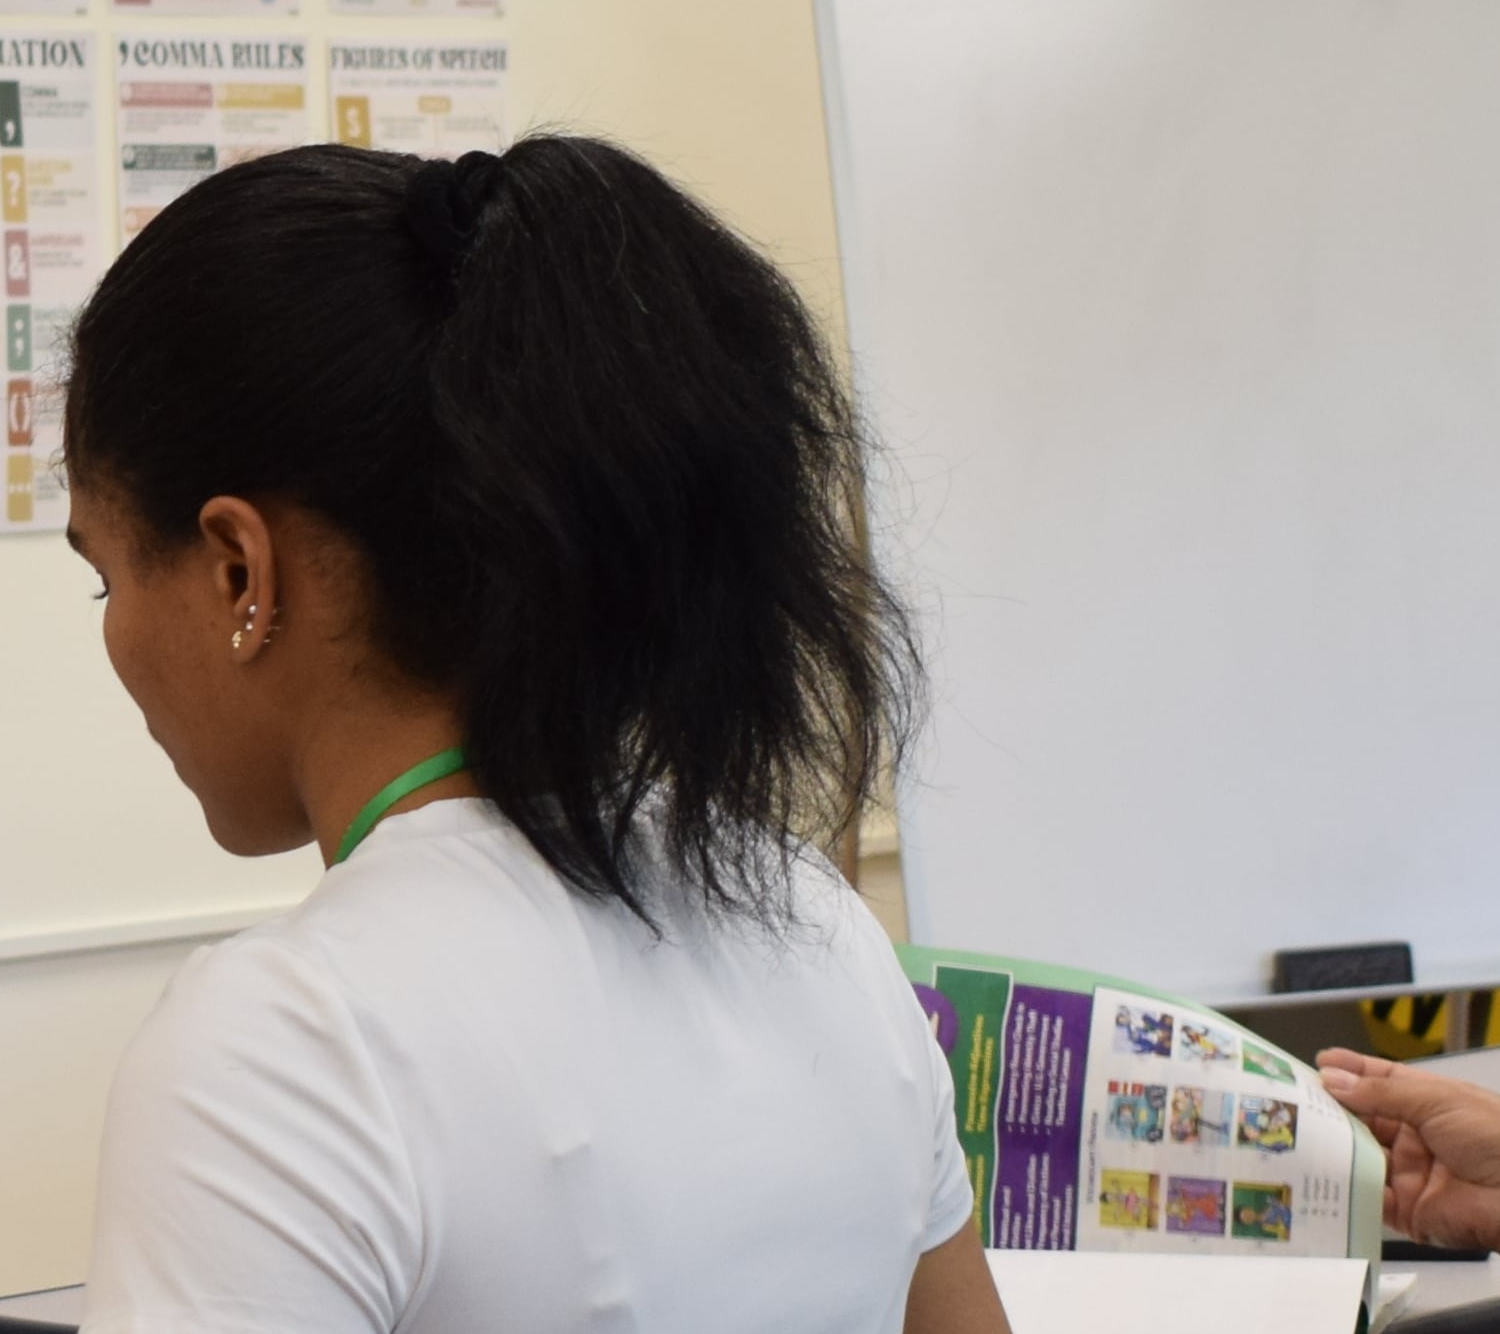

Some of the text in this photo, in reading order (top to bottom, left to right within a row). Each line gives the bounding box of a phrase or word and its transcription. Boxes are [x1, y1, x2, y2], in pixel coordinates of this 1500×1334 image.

[134, 40, 306, 70] COMMA RULES
[330, 46, 507, 72] FIGURES OF SPEECH
